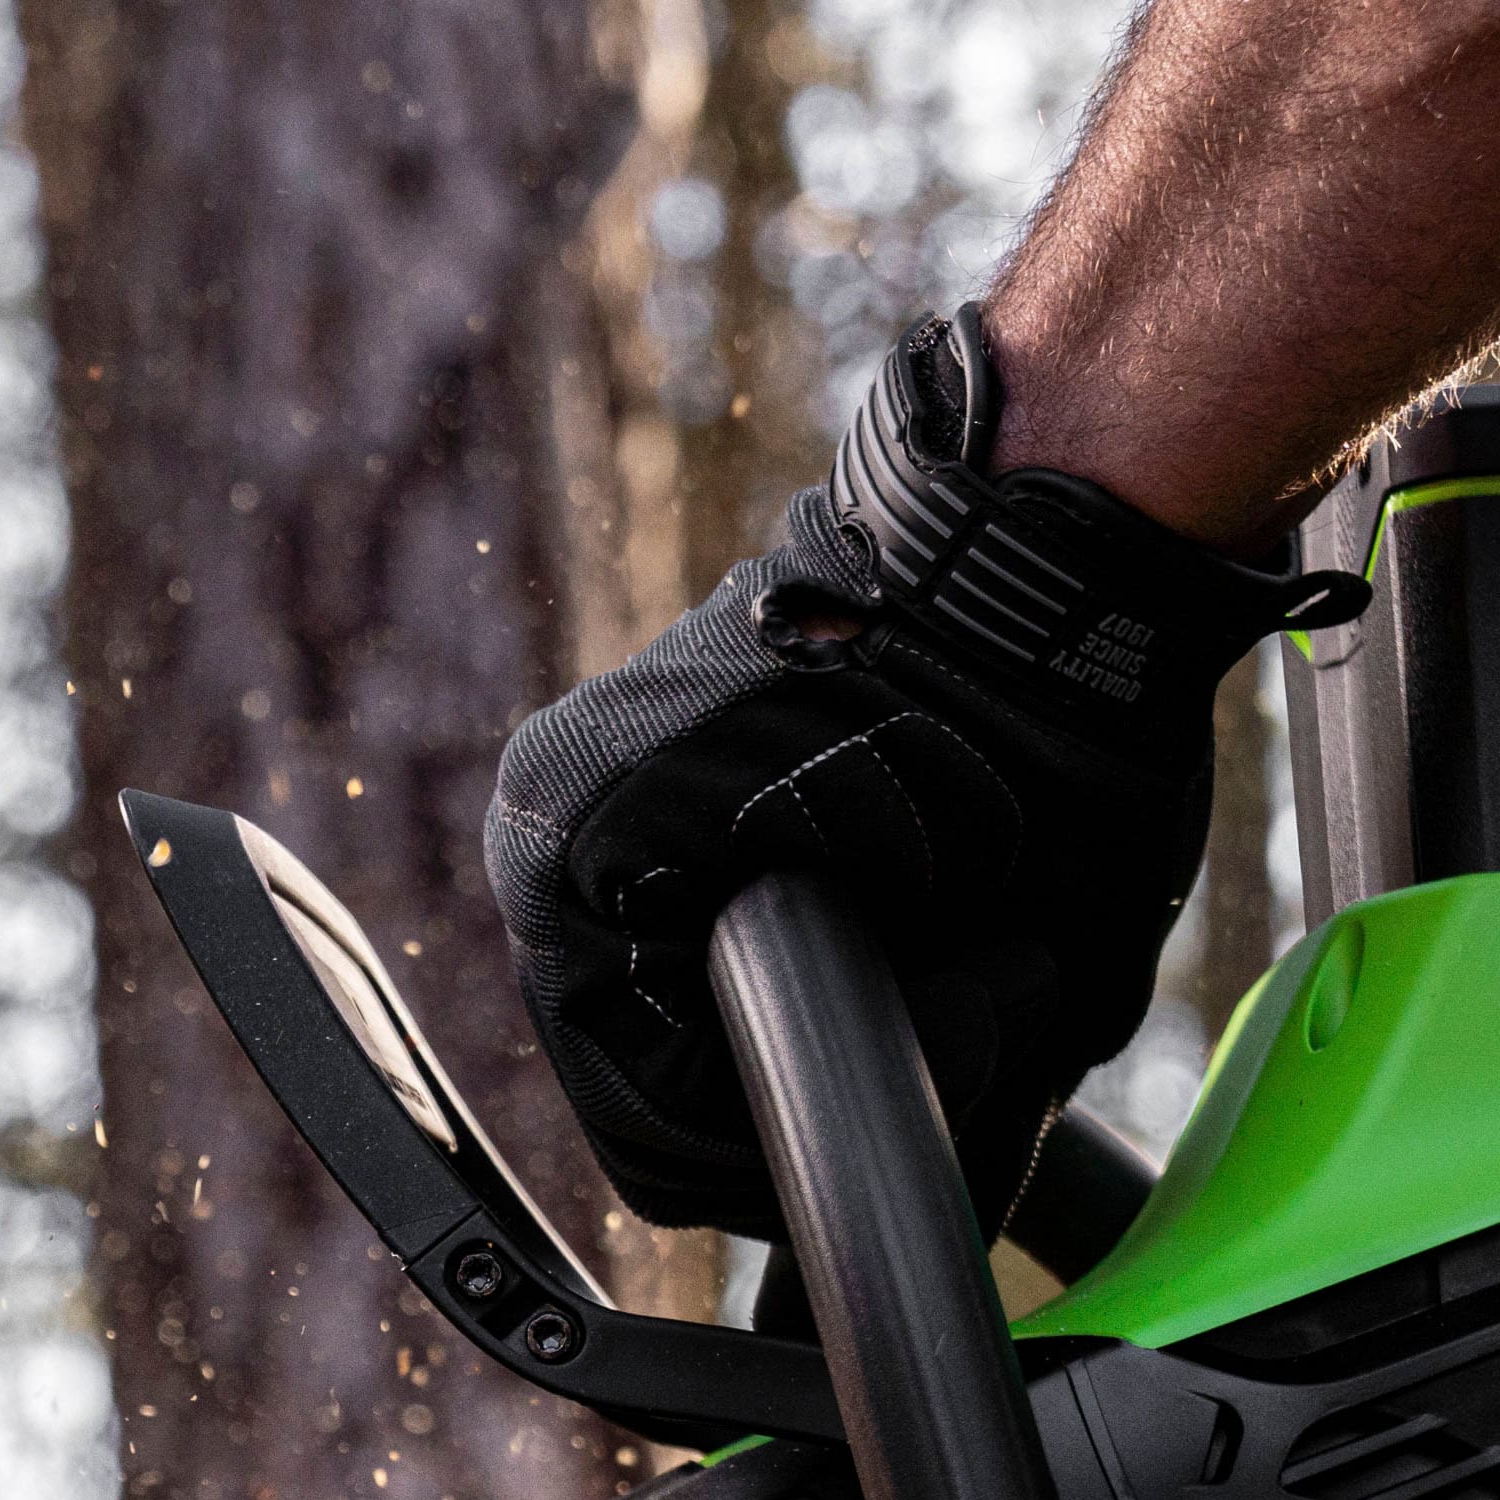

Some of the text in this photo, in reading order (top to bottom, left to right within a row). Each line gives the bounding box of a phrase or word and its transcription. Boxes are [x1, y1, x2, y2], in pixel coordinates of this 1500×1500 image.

[1098, 613, 1155, 647] 1907
[1078, 632, 1146, 675] SINCE
[1049, 649, 1142, 702] QUALITY
